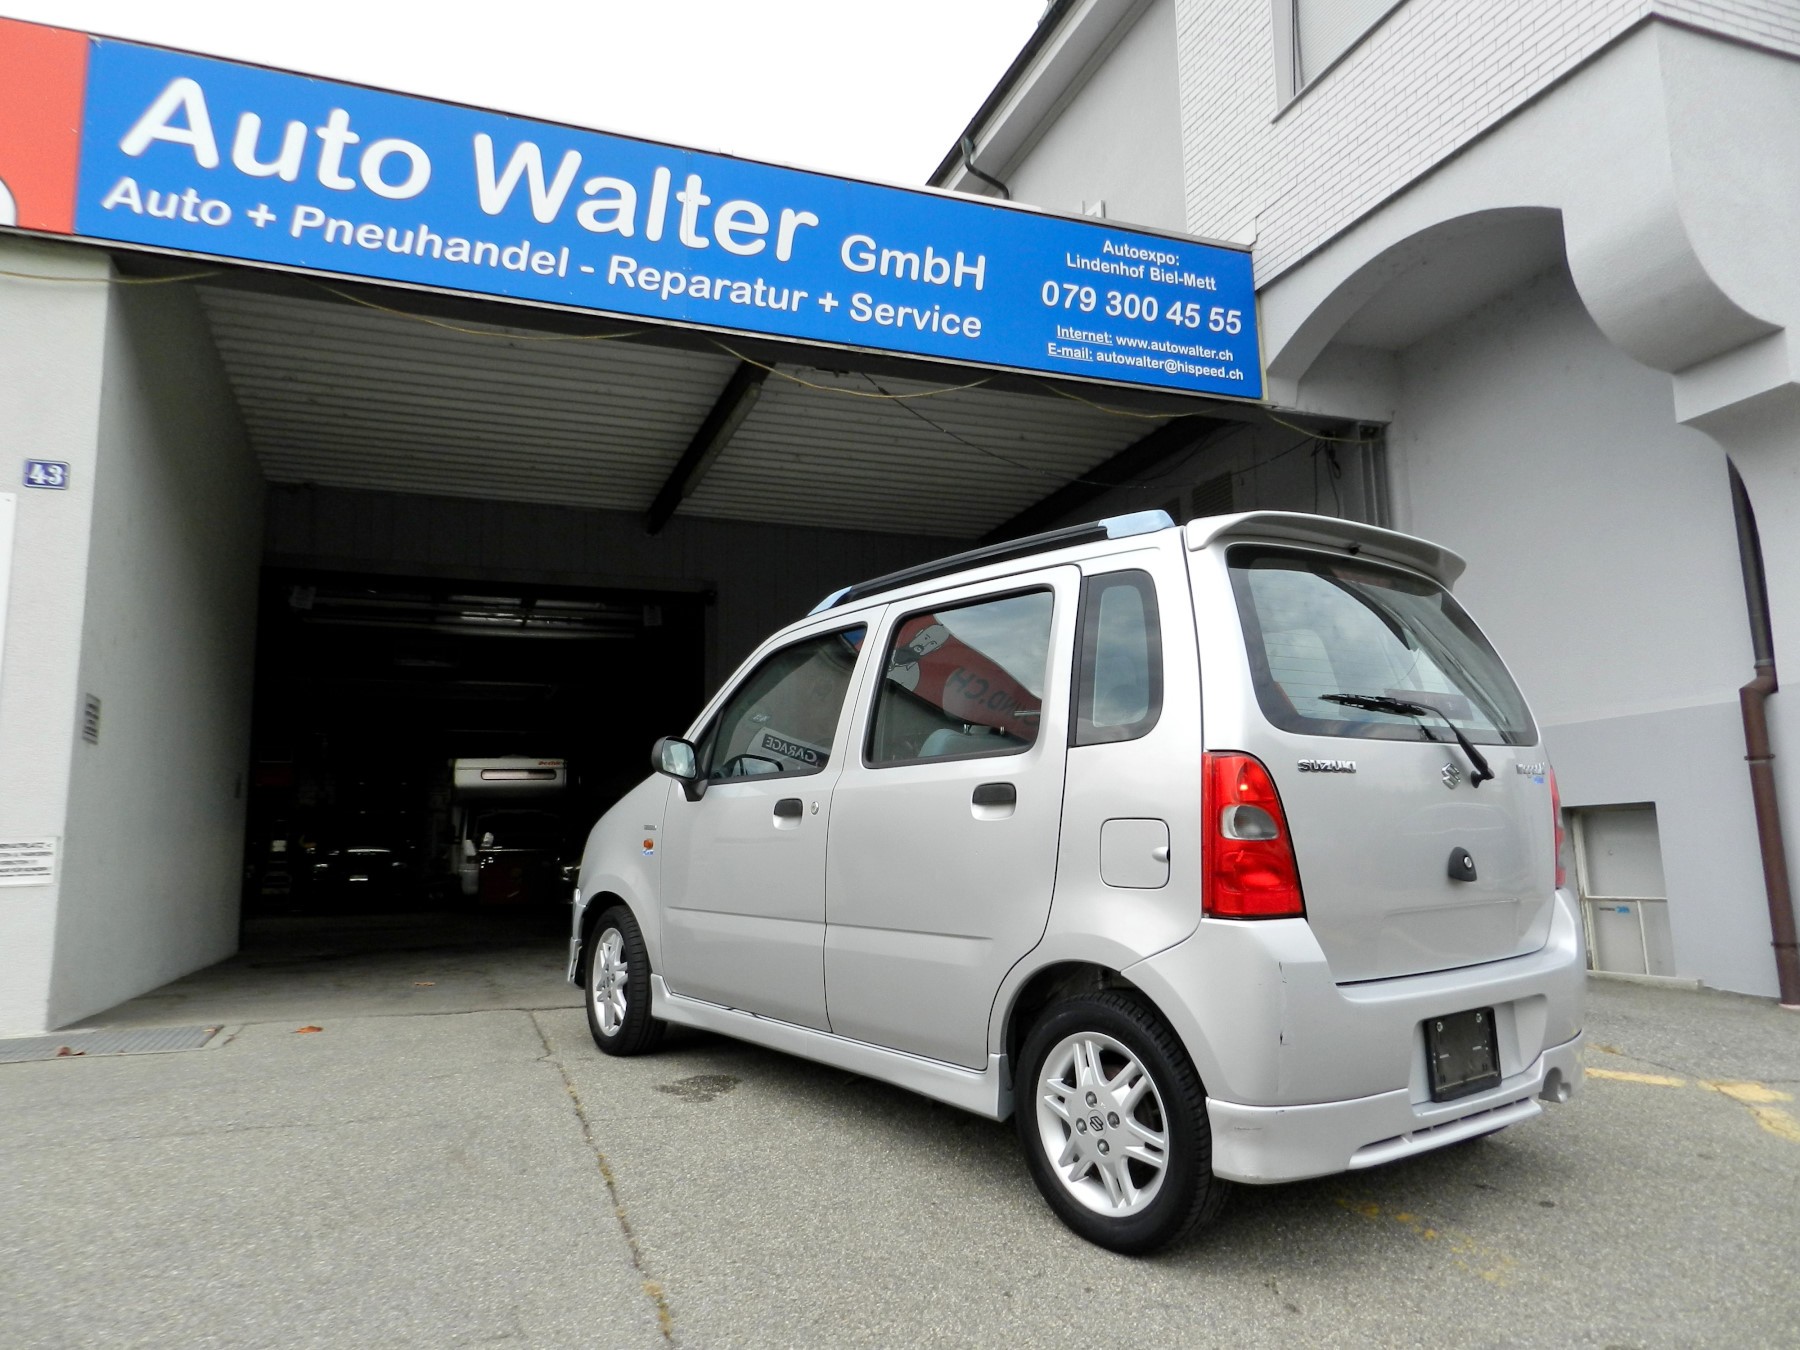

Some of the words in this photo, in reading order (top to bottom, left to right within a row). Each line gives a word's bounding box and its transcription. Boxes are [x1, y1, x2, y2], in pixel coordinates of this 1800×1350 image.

[119, 76, 432, 200] Auto
[473, 132, 819, 262] Walter
[841, 234, 987, 292] GmbH
[101, 176, 232, 226] Auto
[247, 203, 277, 228] +
[290, 204, 570, 278] Pneuhandel
[607, 254, 809, 313] Reparatur
[818, 292, 839, 313] +
[849, 292, 982, 338] Service
[1066, 252, 1145, 279] Lindenhof
[1149, 266, 1217, 291] Biel-Mett
[1102, 239, 1180, 266] Autoexpo:
[1041, 280, 1097, 312] 079
[1105, 290, 1159, 322] 300
[1165, 301, 1201, 328] 45
[1208, 307, 1242, 335] 55
[1047, 342, 1094, 362] E-mail:
[1096, 350, 1244, 381] autowalter@hispeed.ch
[1056, 325, 1113, 346] Internet:
[1116, 334, 1234, 362] www.autowalter.ch
[29, 463, 63, 485] 43
[1297, 759, 1357, 773] SUZUKI
